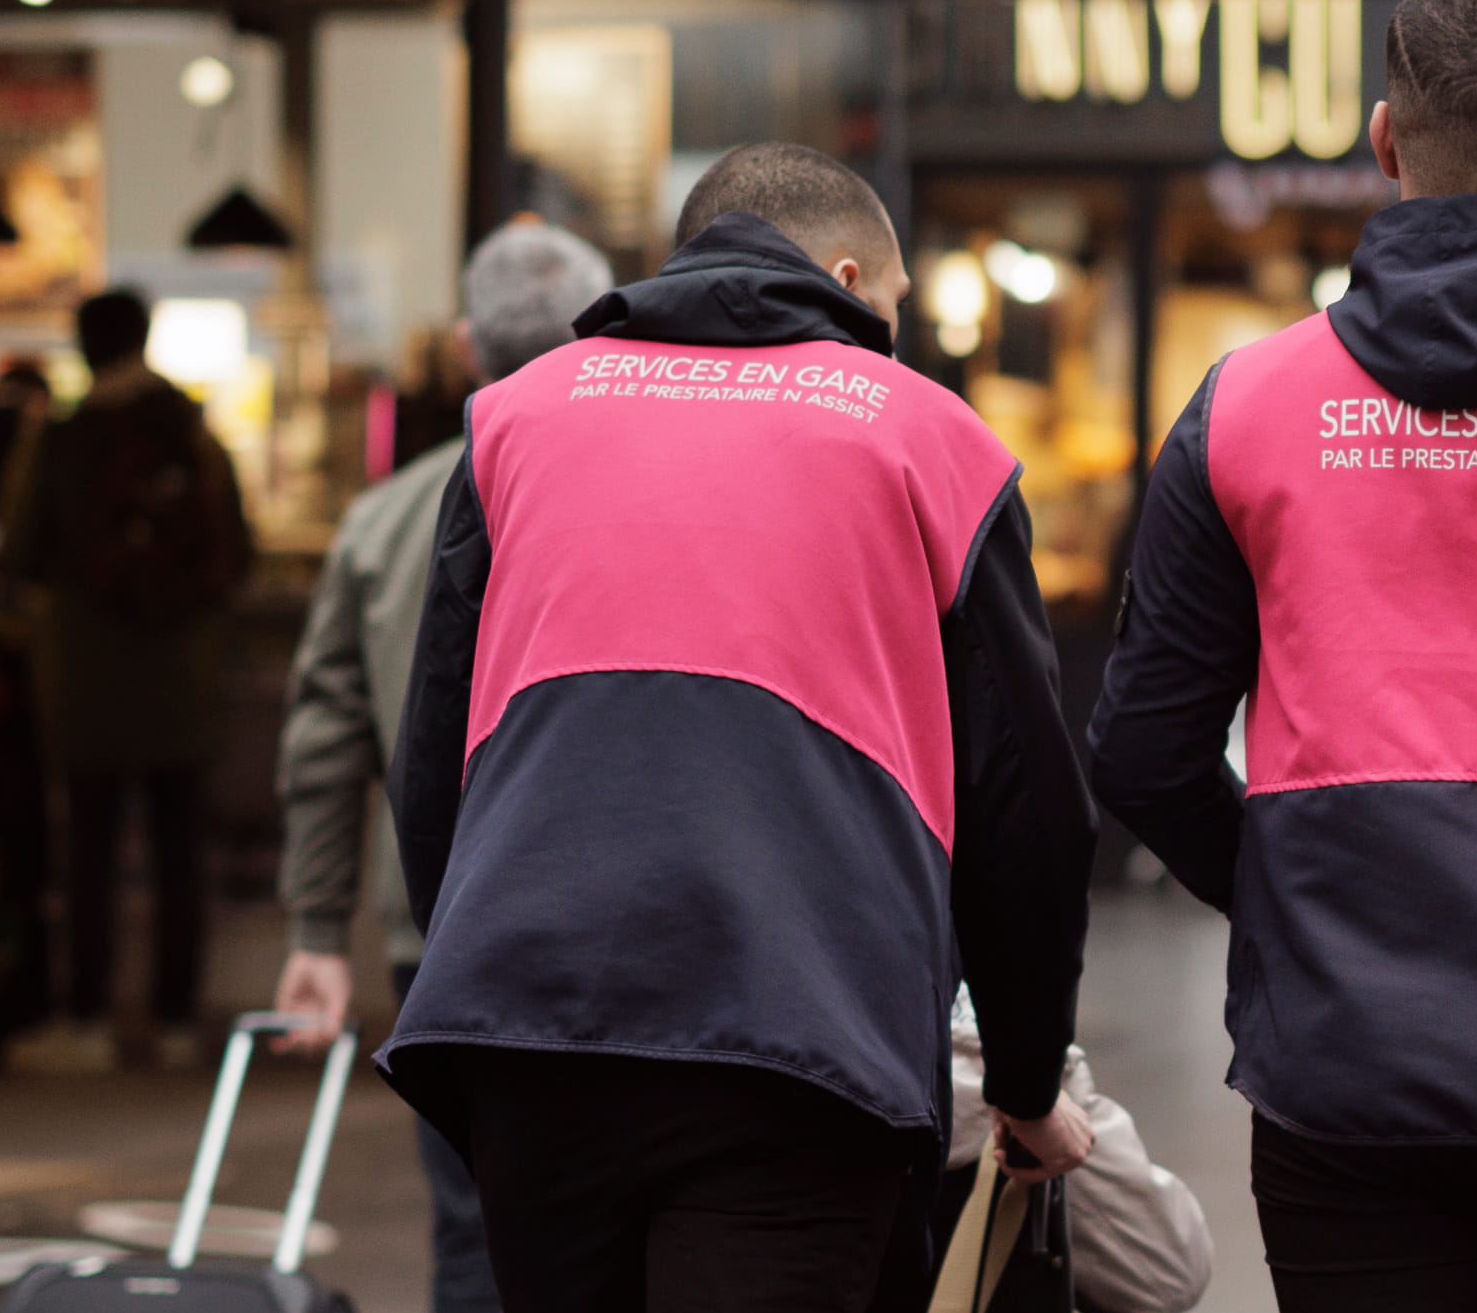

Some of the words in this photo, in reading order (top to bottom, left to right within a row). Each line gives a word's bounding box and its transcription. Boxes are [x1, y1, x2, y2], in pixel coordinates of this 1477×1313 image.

[576, 353, 732, 382] SERVICES
[736, 362, 789, 385] EN
[795, 365, 891, 410] GARE
[569, 382, 610, 402] PAR
[613, 383, 639, 397] LE
[643, 384, 779, 402] PRESTATAIRE
[783, 389, 802, 403] N
[805, 392, 879, 425] ASSIST
[1321, 449, 1362, 470] PAR
[1369, 448, 1395, 469] LE
